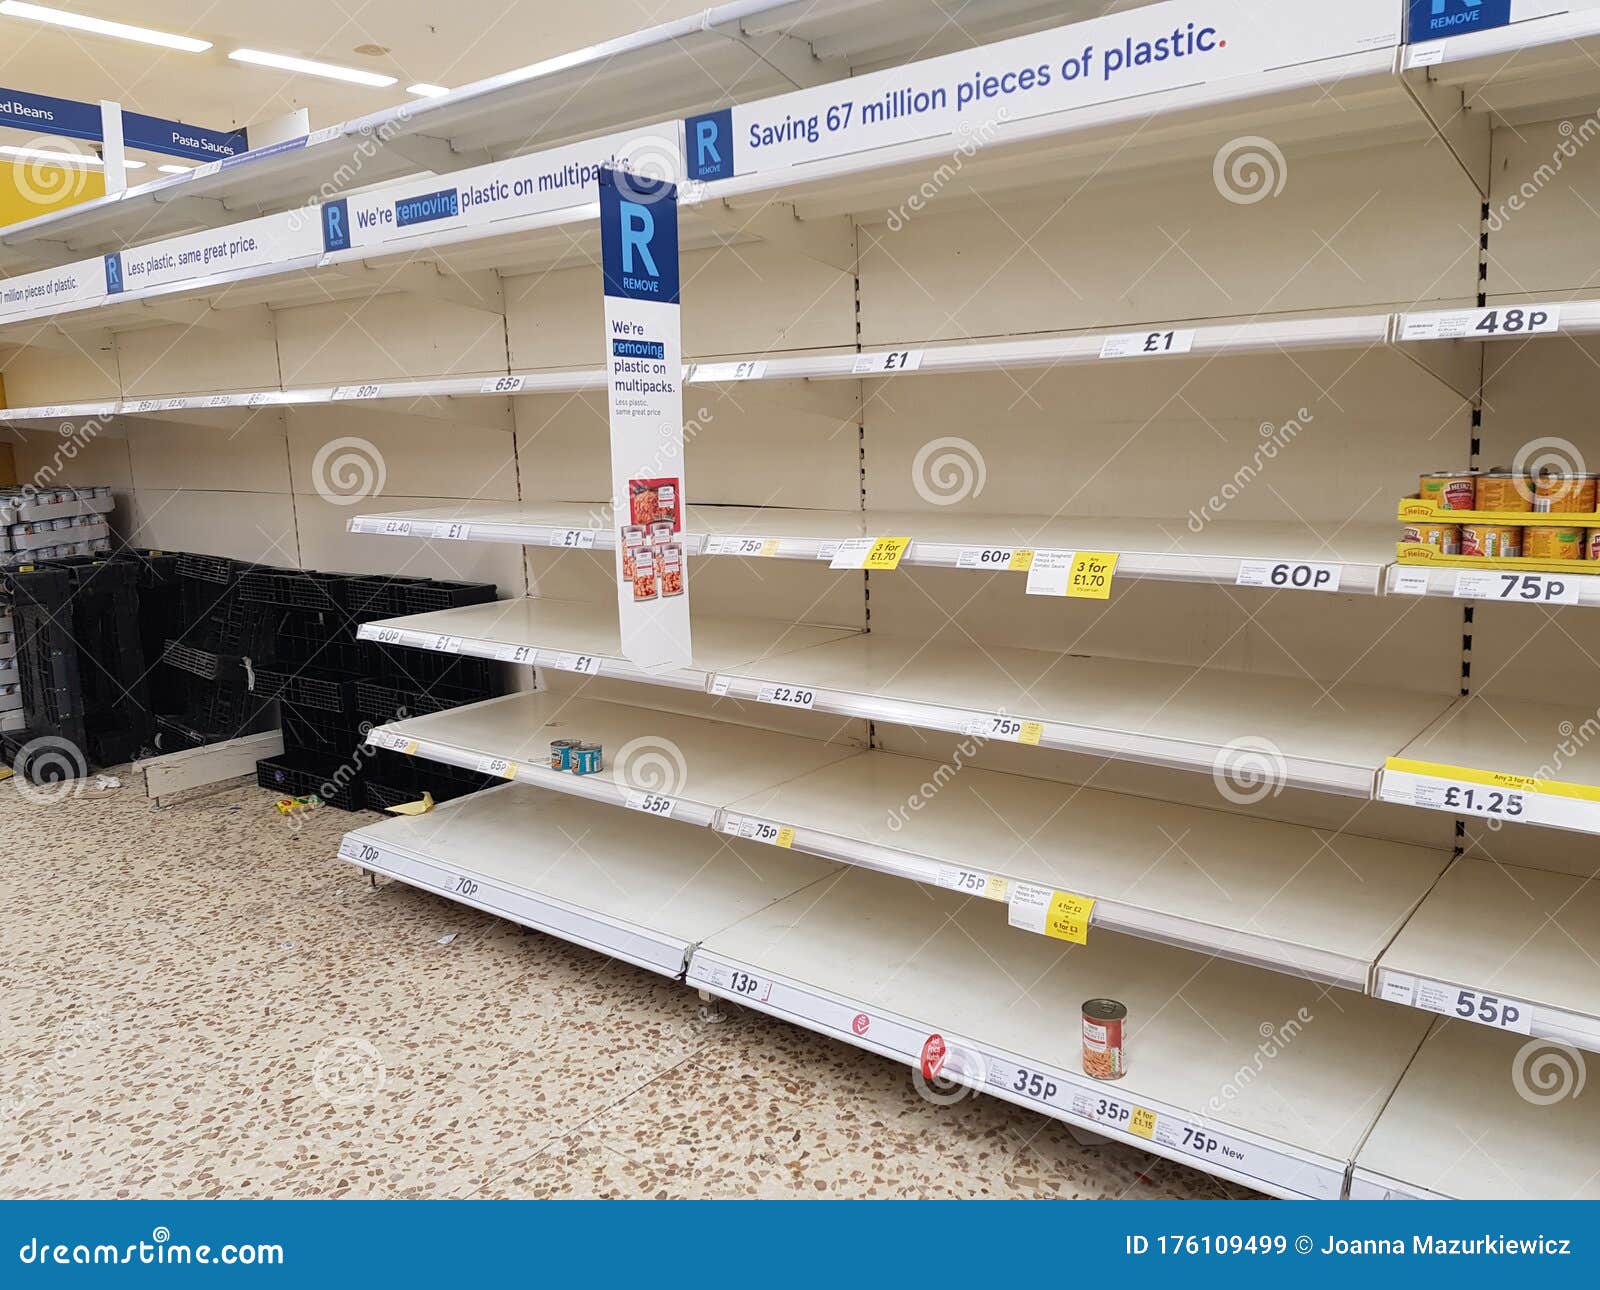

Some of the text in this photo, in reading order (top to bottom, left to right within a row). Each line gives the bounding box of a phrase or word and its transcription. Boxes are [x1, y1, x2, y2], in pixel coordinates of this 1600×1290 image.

[1430, 10, 1480, 29] REMOVE
[749, 22, 1227, 148] Saving 67 million pieces of plastic.
[13, 102, 54, 121] Beans
[172, 131, 200, 148] Pasta
[201, 138, 234, 155] Sauces
[696, 119, 722, 167] R
[357, 208, 393, 229] We're
[397, 194, 458, 223] removing
[461, 180, 509, 212] plastic
[514, 180, 534, 196] on
[327, 206, 344, 240] R
[620, 200, 660, 278] R
[127, 237, 258, 277] Less plastic, same great price.
[108, 256, 120, 283] R
[25, 285, 45, 302] pieces
[46, 280, 53, 294] of
[622, 276, 659, 293] REMOVE
[612, 320, 644, 336] We're
[1476, 309, 1548, 333] 48p
[613, 342, 664, 358] removing
[1143, 331, 1175, 353] £1
[614, 360, 666, 375] plastic on
[884, 352, 909, 369] £1
[733, 362, 755, 378] £1
[356, 385, 377, 398] 80p
[495, 377, 520, 391] 65p
[615, 379, 676, 396] multipacks.
[615, 398, 628, 406] Less
[632, 408, 646, 417] great
[1407, 507, 1430, 516] Heinz
[386, 521, 409, 533] £2.40
[448, 524, 462, 538] £1
[564, 531, 580, 546] £1
[739, 540, 762, 552] 75p
[874, 543, 884, 552] 3
[884, 543, 899, 552] for
[1407, 550, 1430, 559] Heinz
[870, 552, 896, 561] £1.70
[981, 550, 1010, 563] 60p
[1077, 562, 1107, 573] 3 for
[1270, 563, 1331, 588] 60p
[1073, 574, 1105, 587] £1.70
[1500, 575, 1565, 600] 75p
[378, 628, 399, 642] 60p
[435, 637, 450, 650] £1
[513, 646, 530, 661] £1
[574, 656, 592, 672] £1
[773, 688, 812, 704] £2.50
[992, 718, 1021, 734] 75p
[490, 760, 506, 772] 65p
[642, 794, 671, 813] 55p
[1444, 786, 1523, 816] £1.25
[755, 823, 777, 839] 75p
[359, 844, 379, 862] 70p
[455, 877, 478, 896] 70p
[957, 872, 985, 890] 75p
[1063, 903, 1072, 911] for
[1059, 922, 1069, 930] for
[730, 971, 757, 994] 13p
[1456, 991, 1520, 1026] 55p
[1013, 1069, 1057, 1100] 35p
[1096, 1100, 1129, 1121] 35p
[1142, 1111, 1154, 1120] for
[1181, 1127, 1218, 1152] 75p
[1221, 1145, 1245, 1160] New
